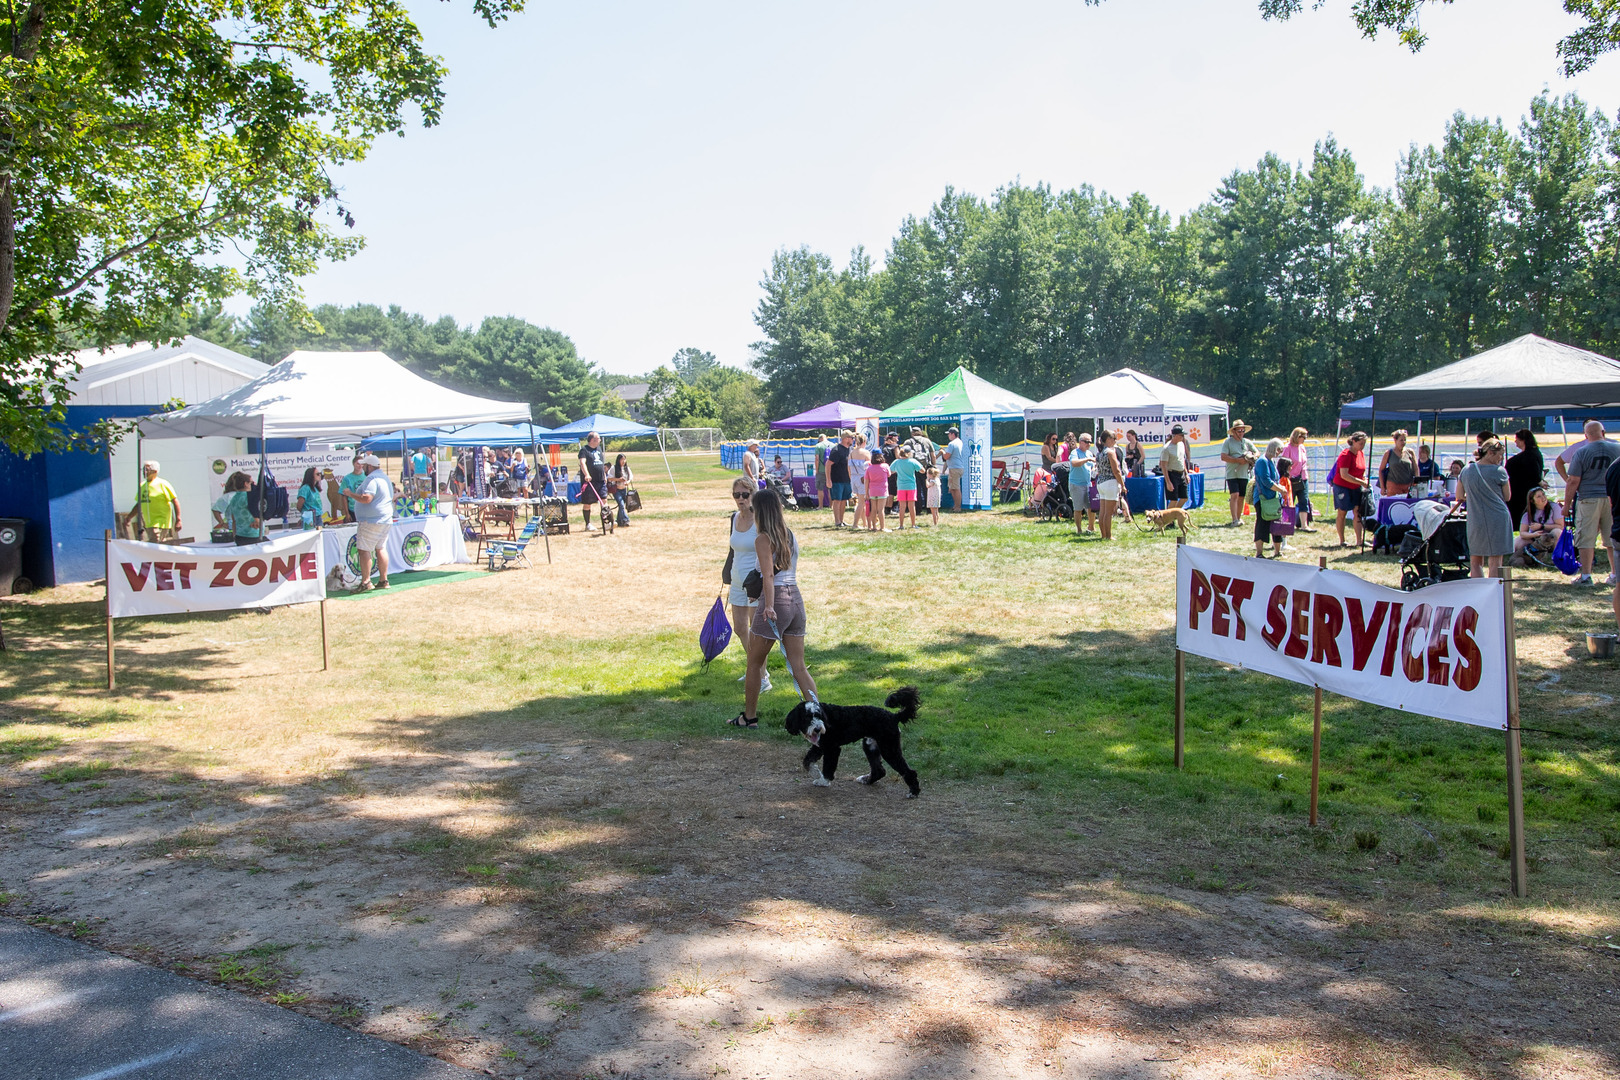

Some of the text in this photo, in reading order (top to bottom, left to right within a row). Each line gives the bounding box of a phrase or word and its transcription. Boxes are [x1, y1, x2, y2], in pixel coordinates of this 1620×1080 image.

[1172, 414, 1199, 422] New
[231, 458, 254, 467] Maine
[255, 456, 295, 466] Verinary
[297, 455, 324, 463] Medical
[326, 454, 351, 462] Center
[120, 561, 198, 592] VET
[209, 552, 318, 588] ZONE
[1190, 568, 1483, 692] PET SERVICES
